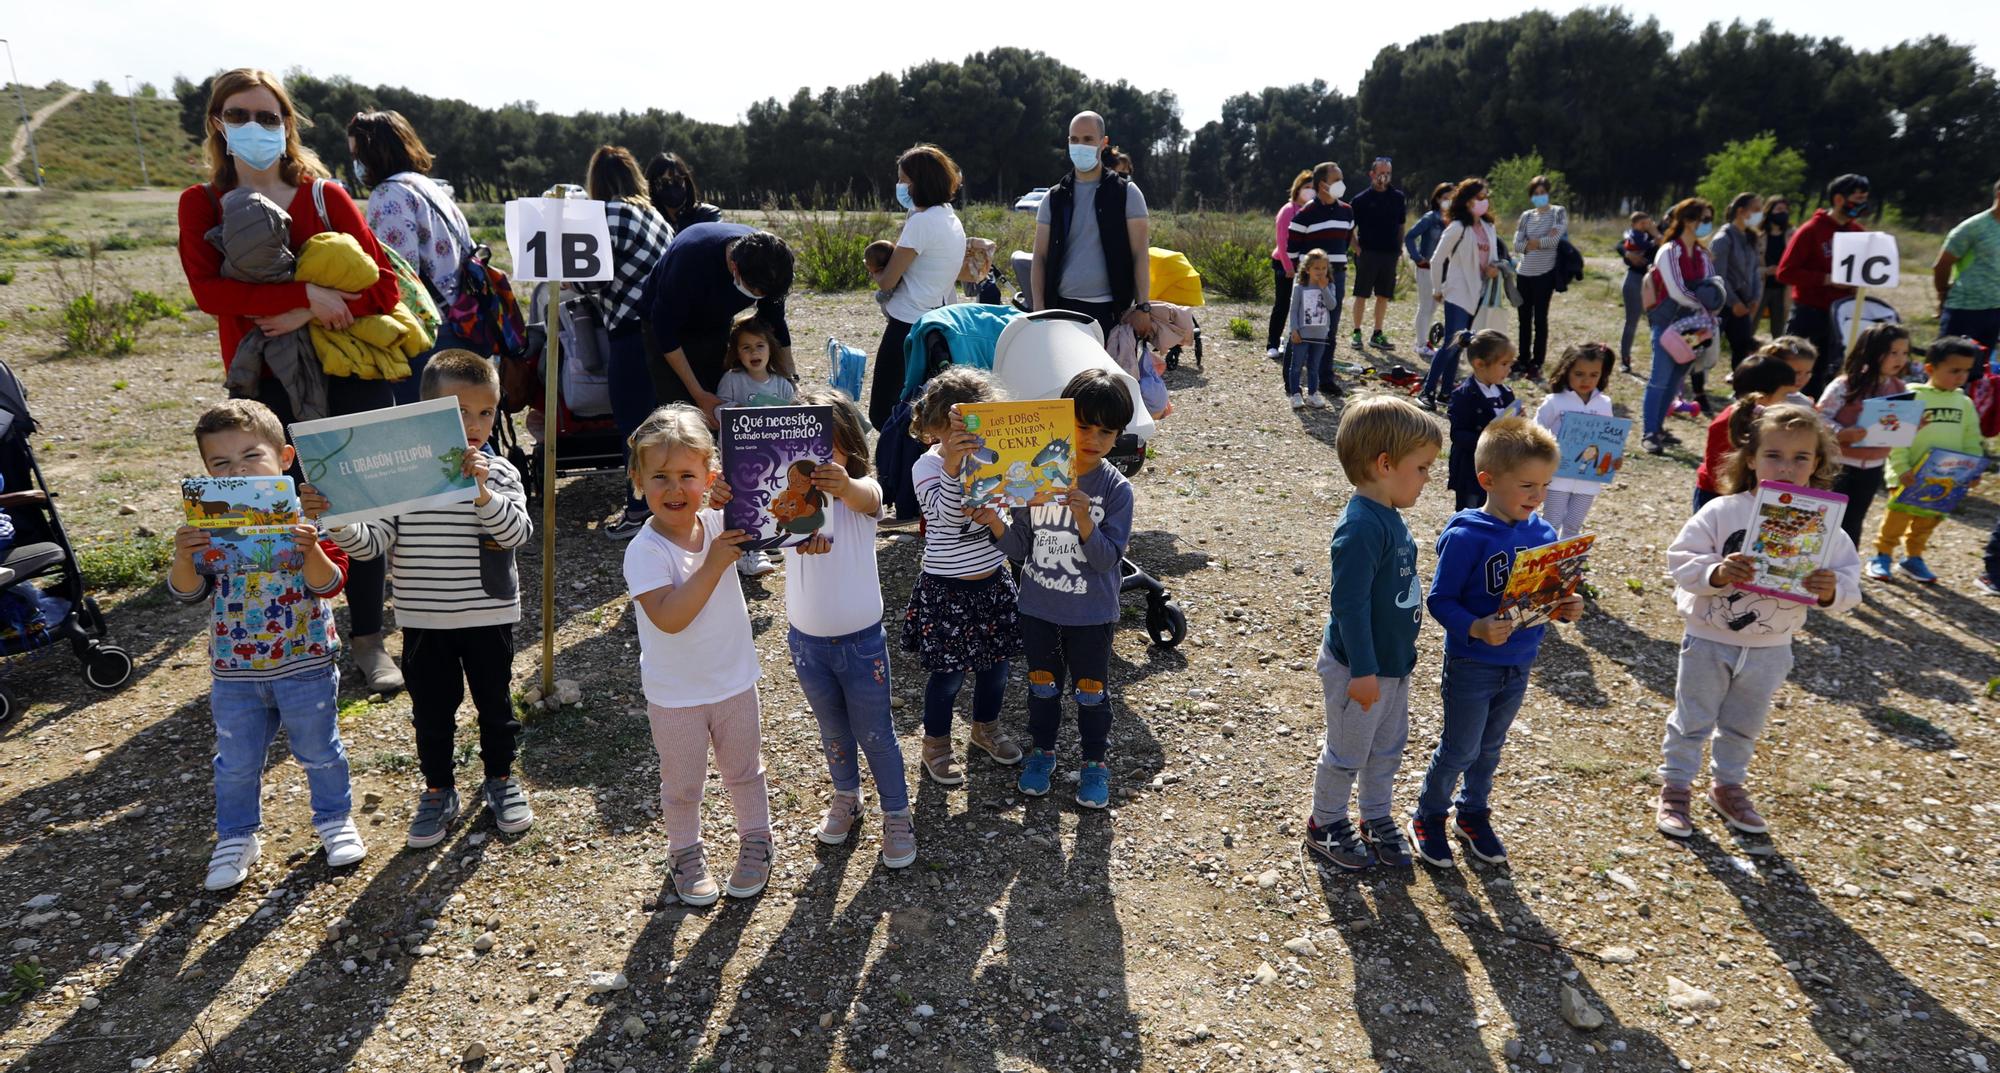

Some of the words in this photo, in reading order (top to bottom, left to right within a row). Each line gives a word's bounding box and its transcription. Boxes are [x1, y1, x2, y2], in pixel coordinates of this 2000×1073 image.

[732, 415, 763, 432] ¿Qué
[766, 412, 816, 427] necesito
[1008, 412, 1041, 426] LOBOS
[1923, 409, 1962, 423] AME
[734, 431, 760, 440] cuando
[761, 431, 780, 440] tengo
[780, 422, 823, 440] miedo?
[985, 428, 1002, 437] QUE
[1048, 421, 1055, 431] A
[998, 436, 1040, 450] CENAR
[339, 461, 352, 475] EL
[352, 451, 393, 473] DRAGÓN
[394, 443, 433, 464] FELIPÓN
[1048, 543, 1078, 555] WALK
